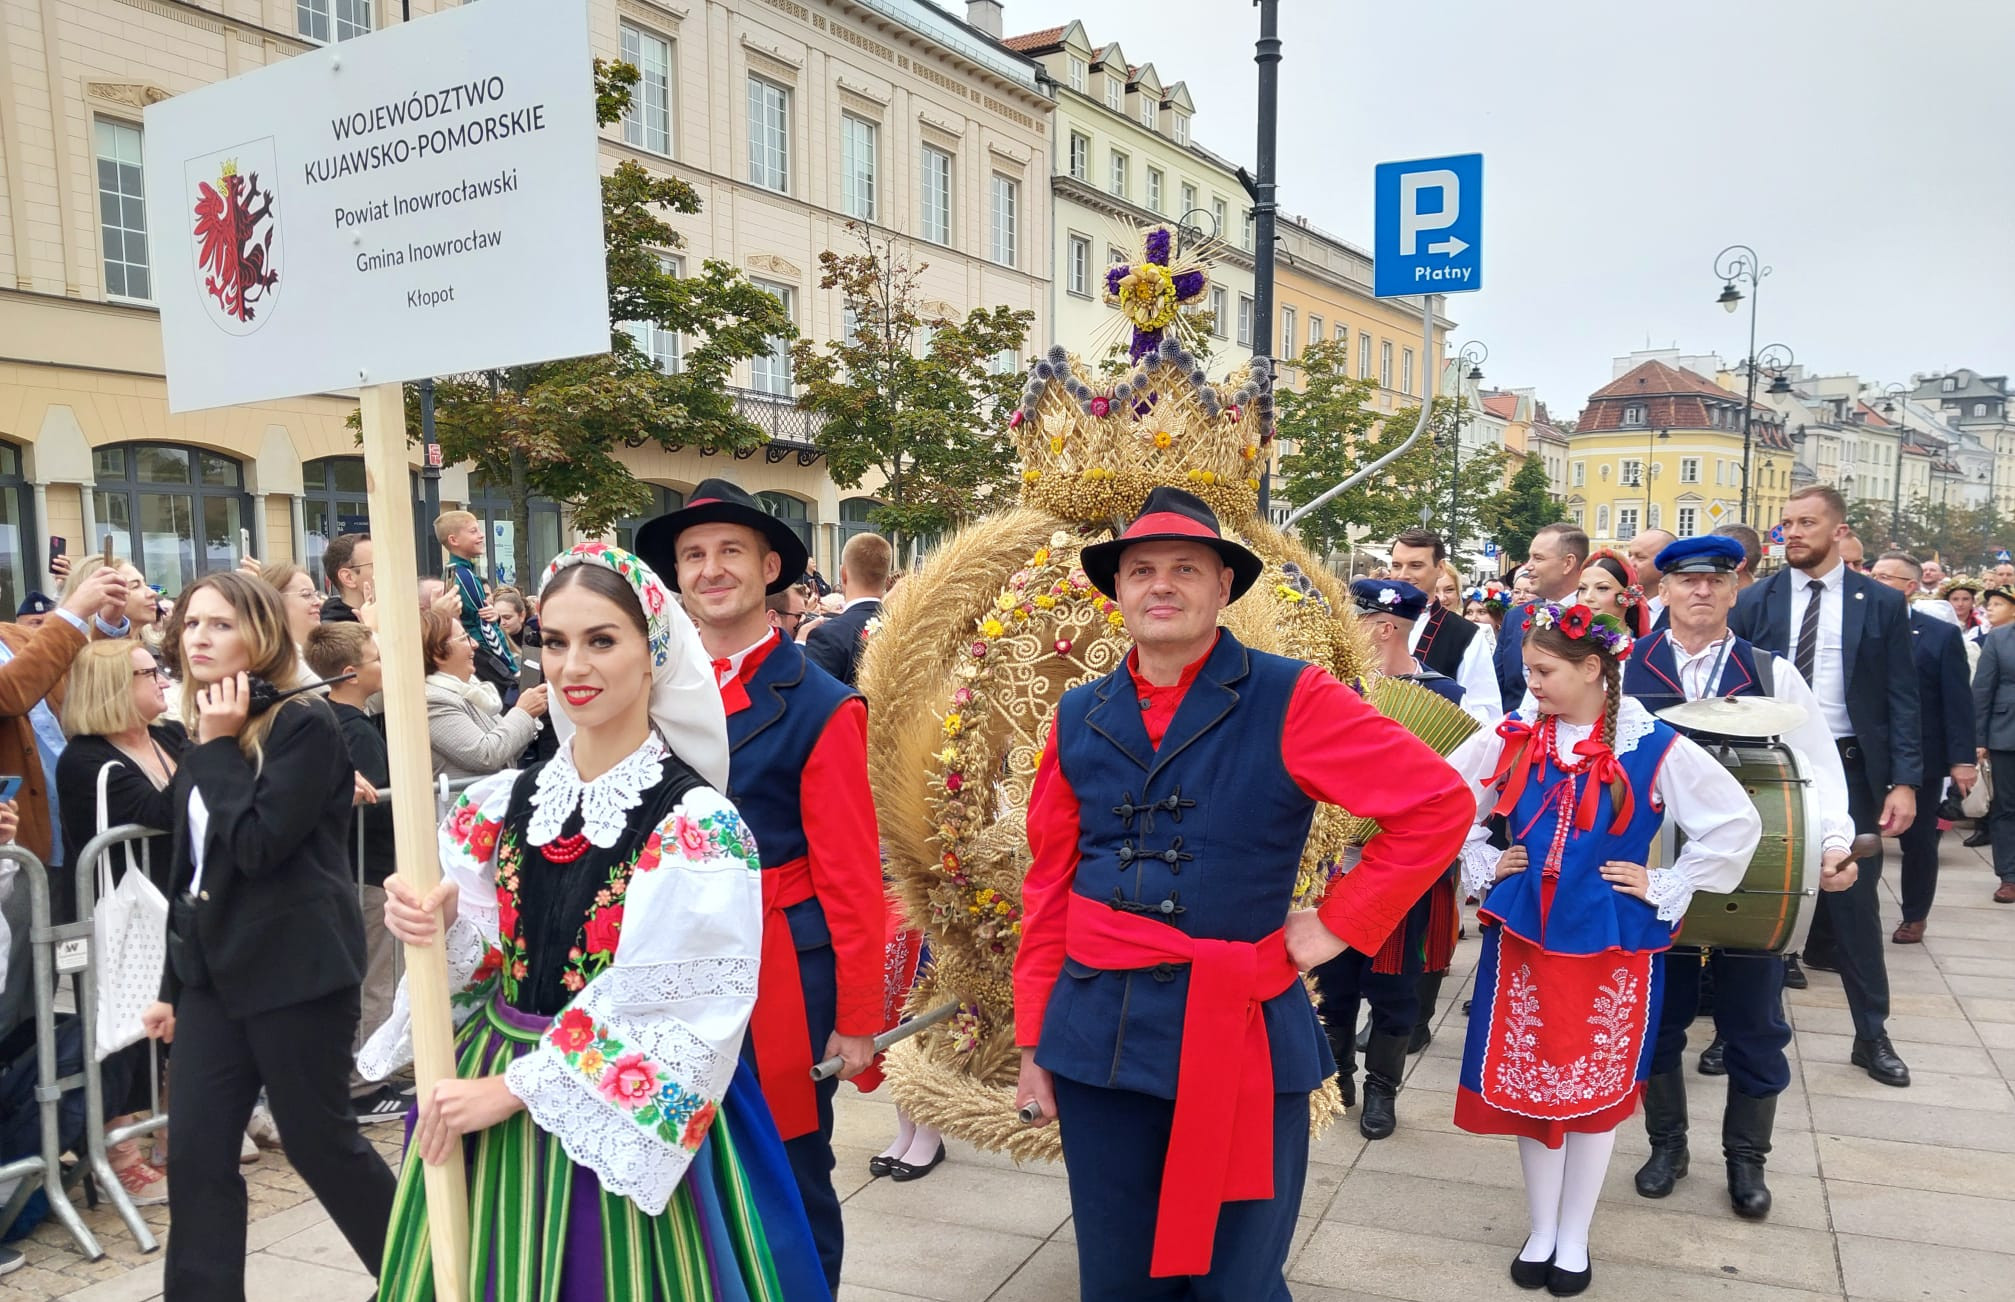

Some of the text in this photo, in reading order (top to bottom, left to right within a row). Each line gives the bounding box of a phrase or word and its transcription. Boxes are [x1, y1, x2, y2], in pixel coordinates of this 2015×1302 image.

[331, 76, 504, 141] WOJEWÓDZTWO
[304, 104, 546, 185] KUJAWSKO-POMORSKIE
[335, 168, 518, 229] Powiat Inowrocławski
[1400, 169, 1460, 256] P
[356, 229, 502, 272] Gmina Inowrocław
[1415, 265, 1472, 282] Płatny
[407, 285, 455, 308] Kłopot
